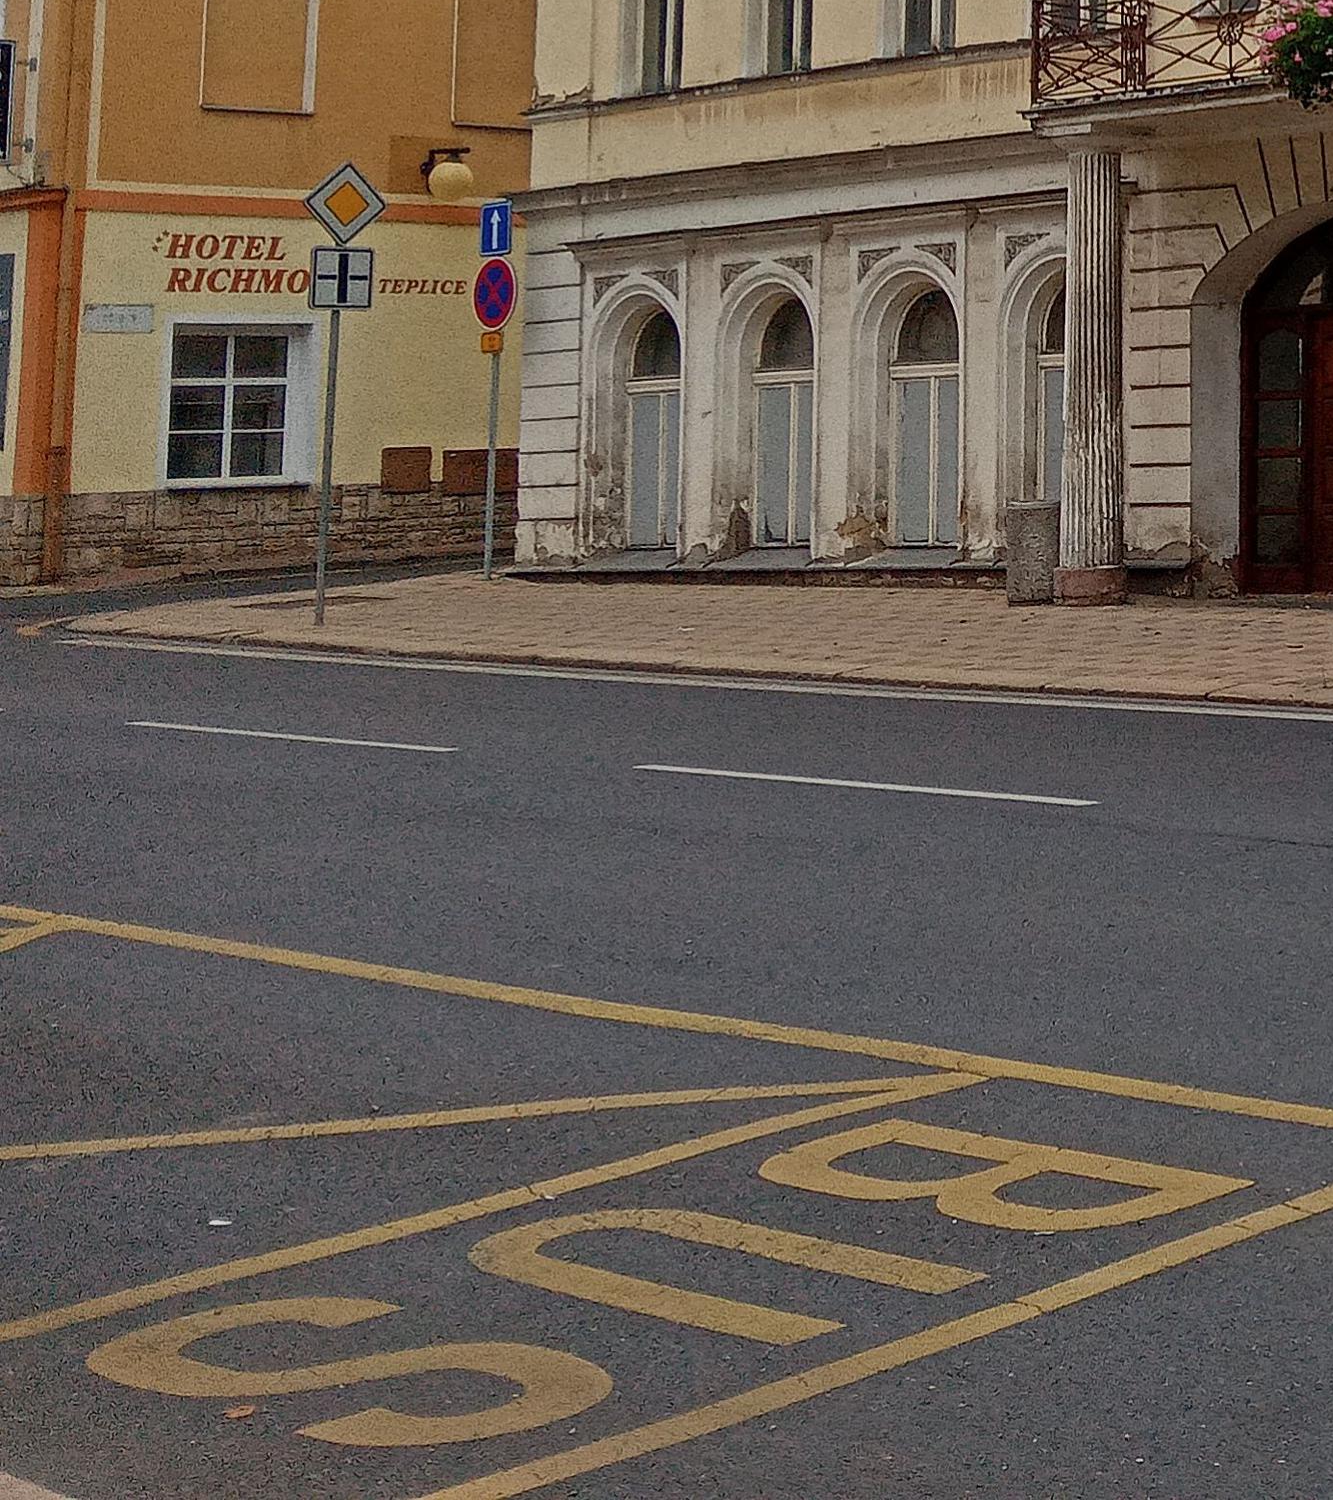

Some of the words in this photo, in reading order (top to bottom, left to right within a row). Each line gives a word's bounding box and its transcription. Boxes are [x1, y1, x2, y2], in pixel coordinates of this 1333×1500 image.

[164, 233, 288, 261] HOTEL
[164, 267, 310, 294] RICHMO
[379, 278, 467, 295] TEPLICE
[86, 1117, 1256, 1448] BUS
